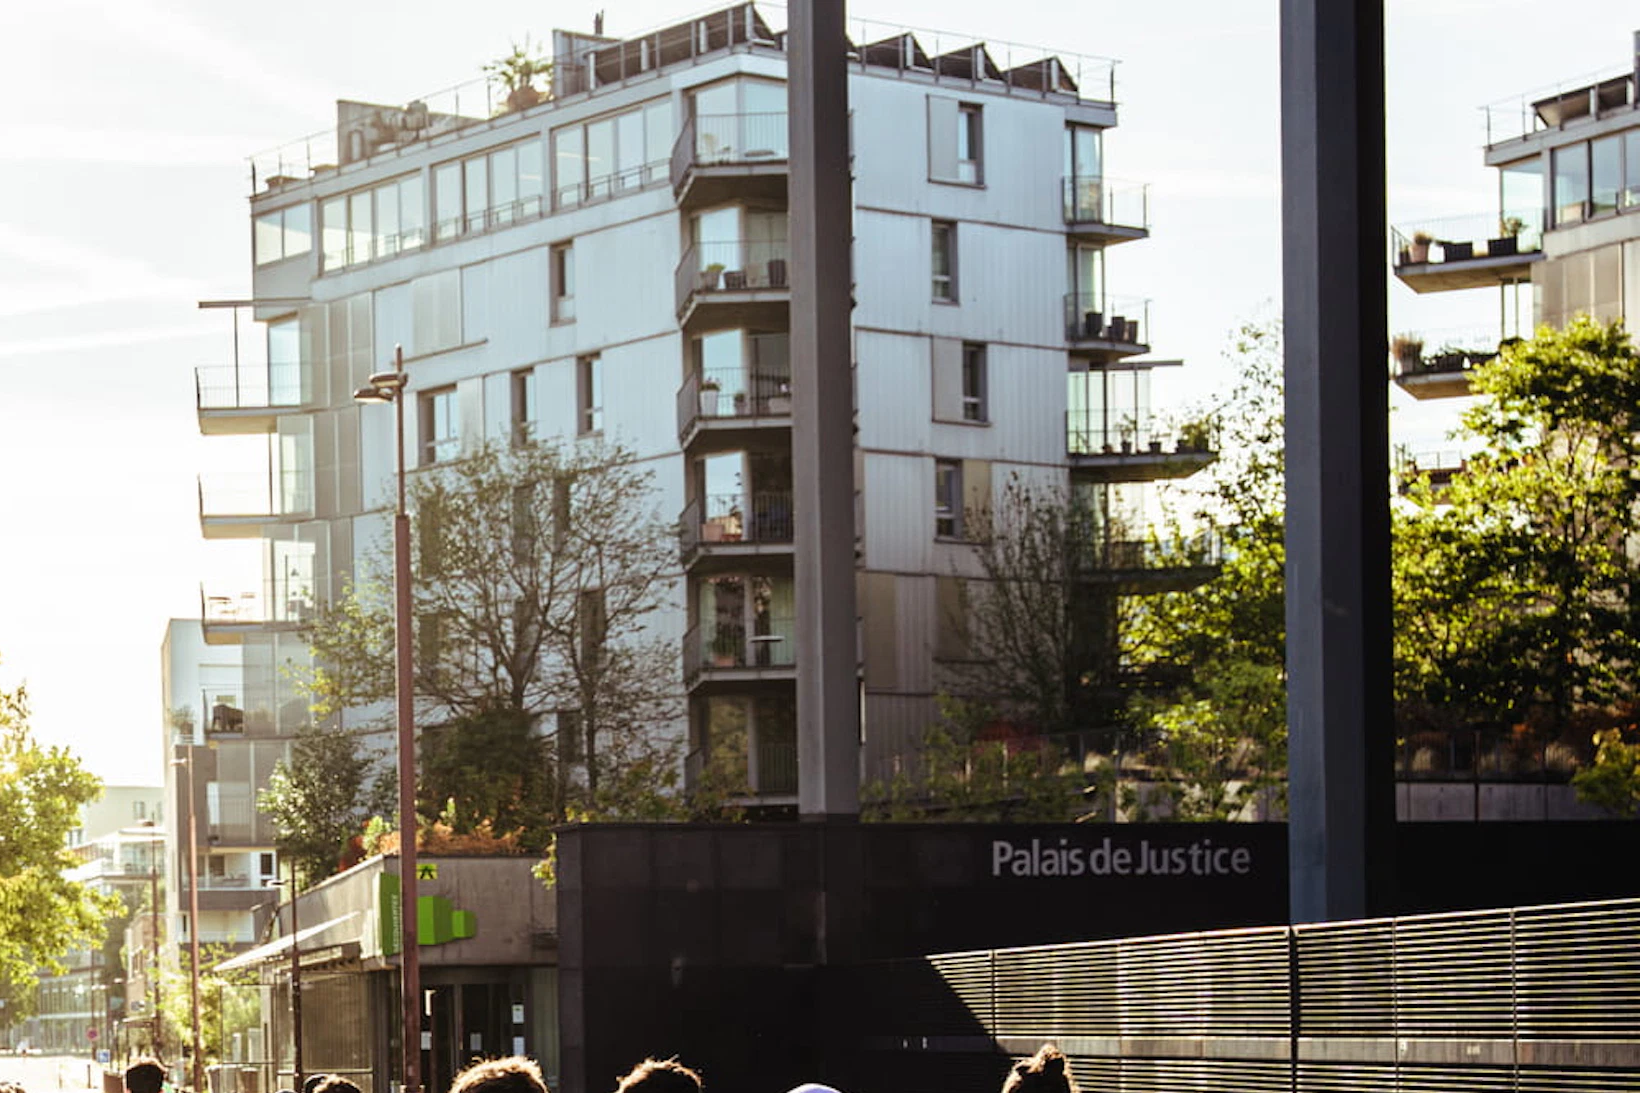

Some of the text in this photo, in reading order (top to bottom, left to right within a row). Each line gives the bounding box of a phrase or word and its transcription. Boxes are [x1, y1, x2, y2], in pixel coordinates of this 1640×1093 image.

[992, 838, 1251, 877] Palais de Justice
